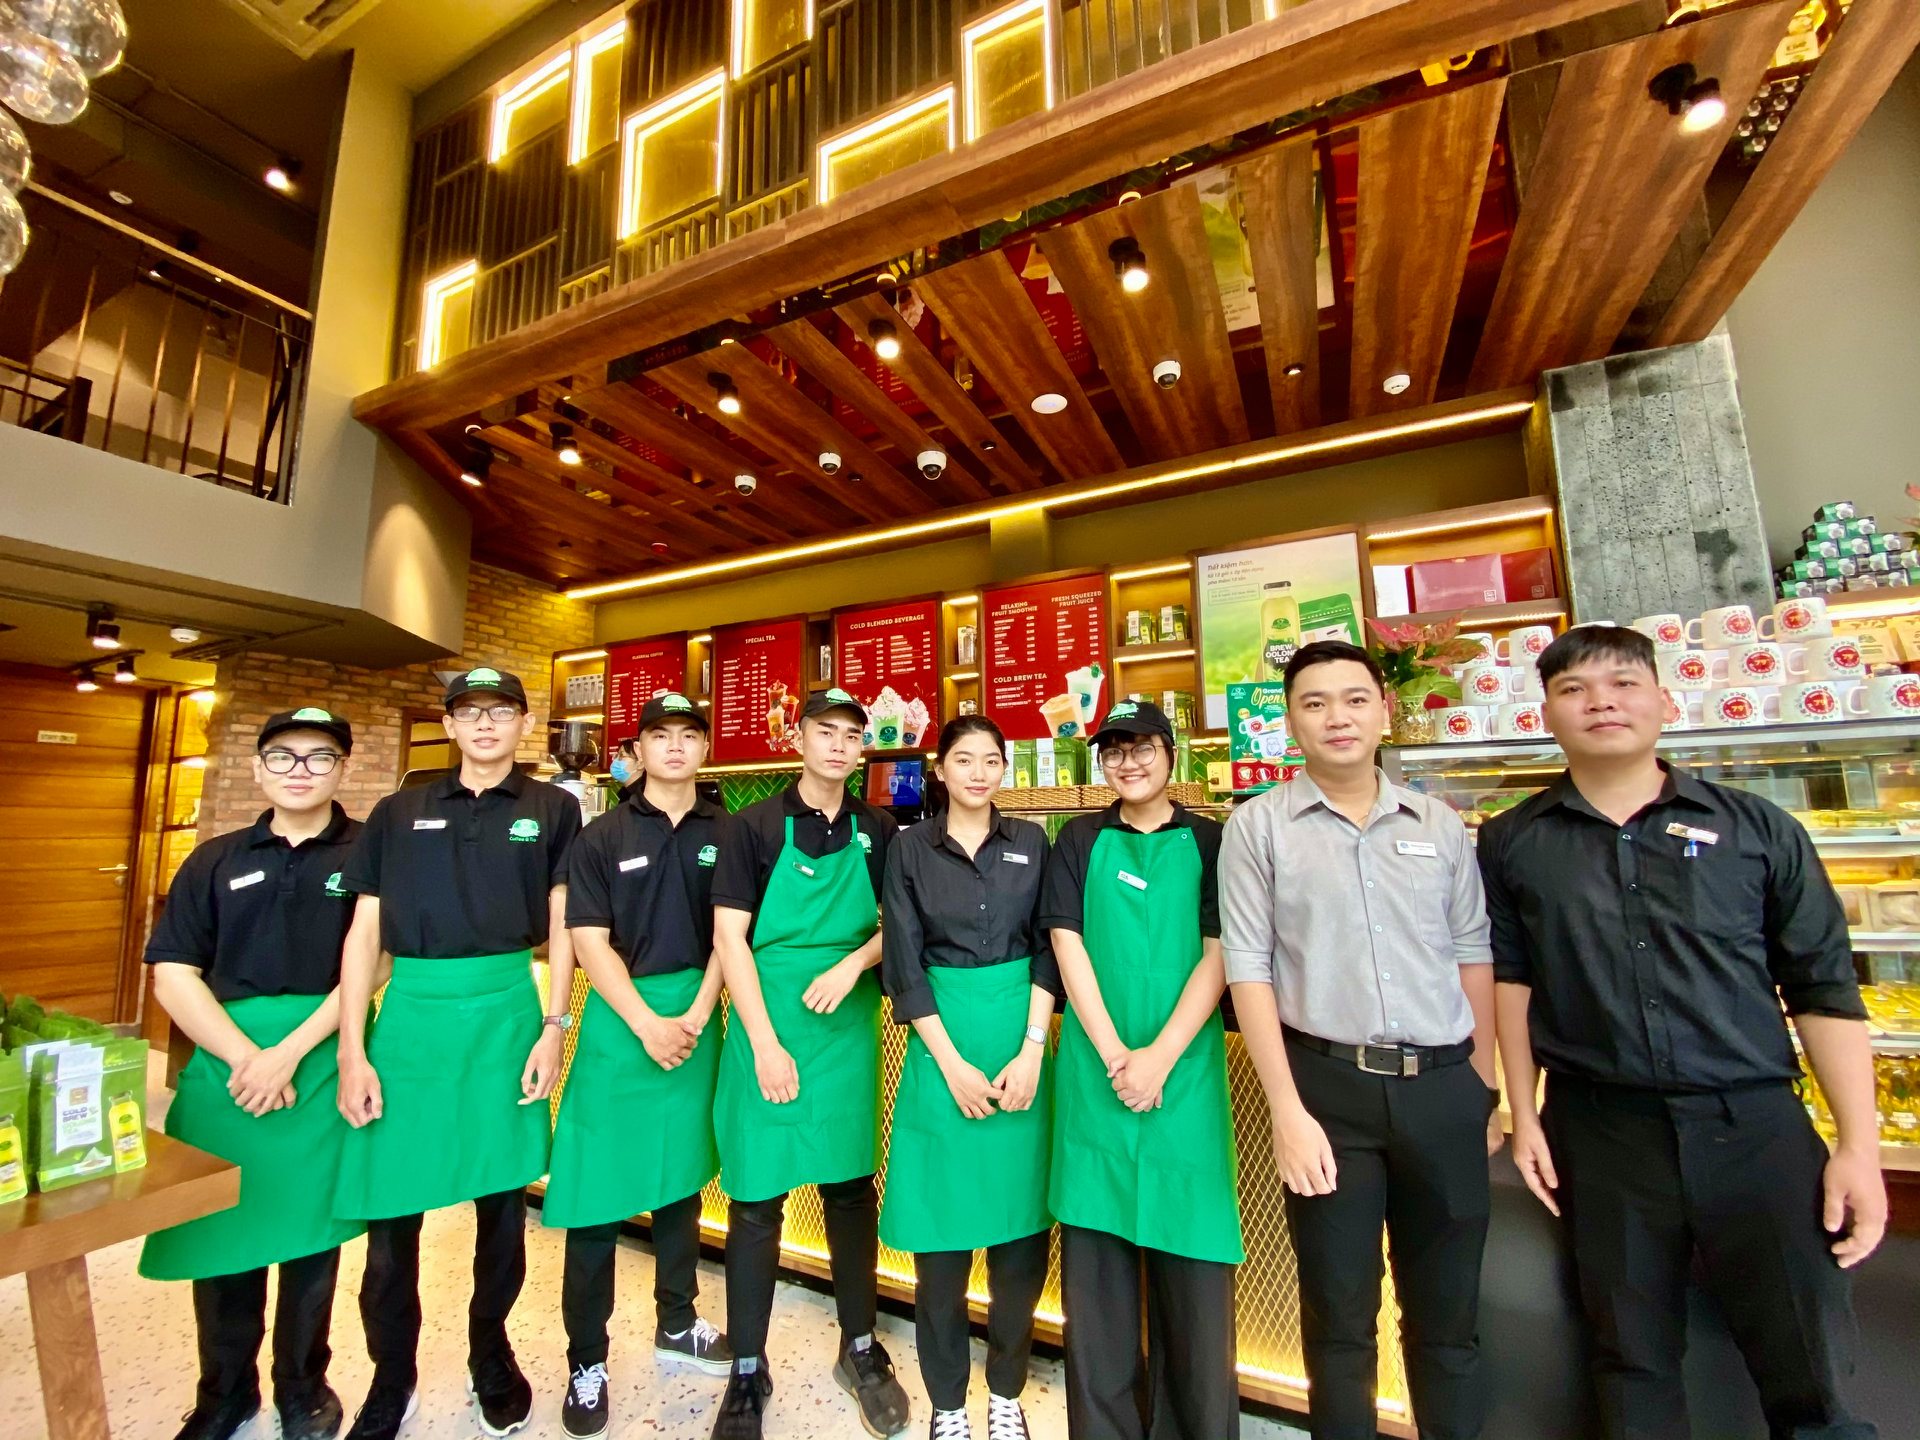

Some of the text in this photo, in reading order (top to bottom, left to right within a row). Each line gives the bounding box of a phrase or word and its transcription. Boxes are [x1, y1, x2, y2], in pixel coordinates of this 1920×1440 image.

[1071, 591, 1102, 600] SQUEEZED
[1001, 601, 1028, 610] RELAXING
[1009, 606, 1037, 614] SMOOTHIE
[867, 619, 893, 628] BLENDED
[895, 614, 924, 623] BEVERAGE
[1014, 674, 1033, 682] BREW
[63, 1107, 87, 1116] COLD
[63, 1113, 87, 1122] BREW
